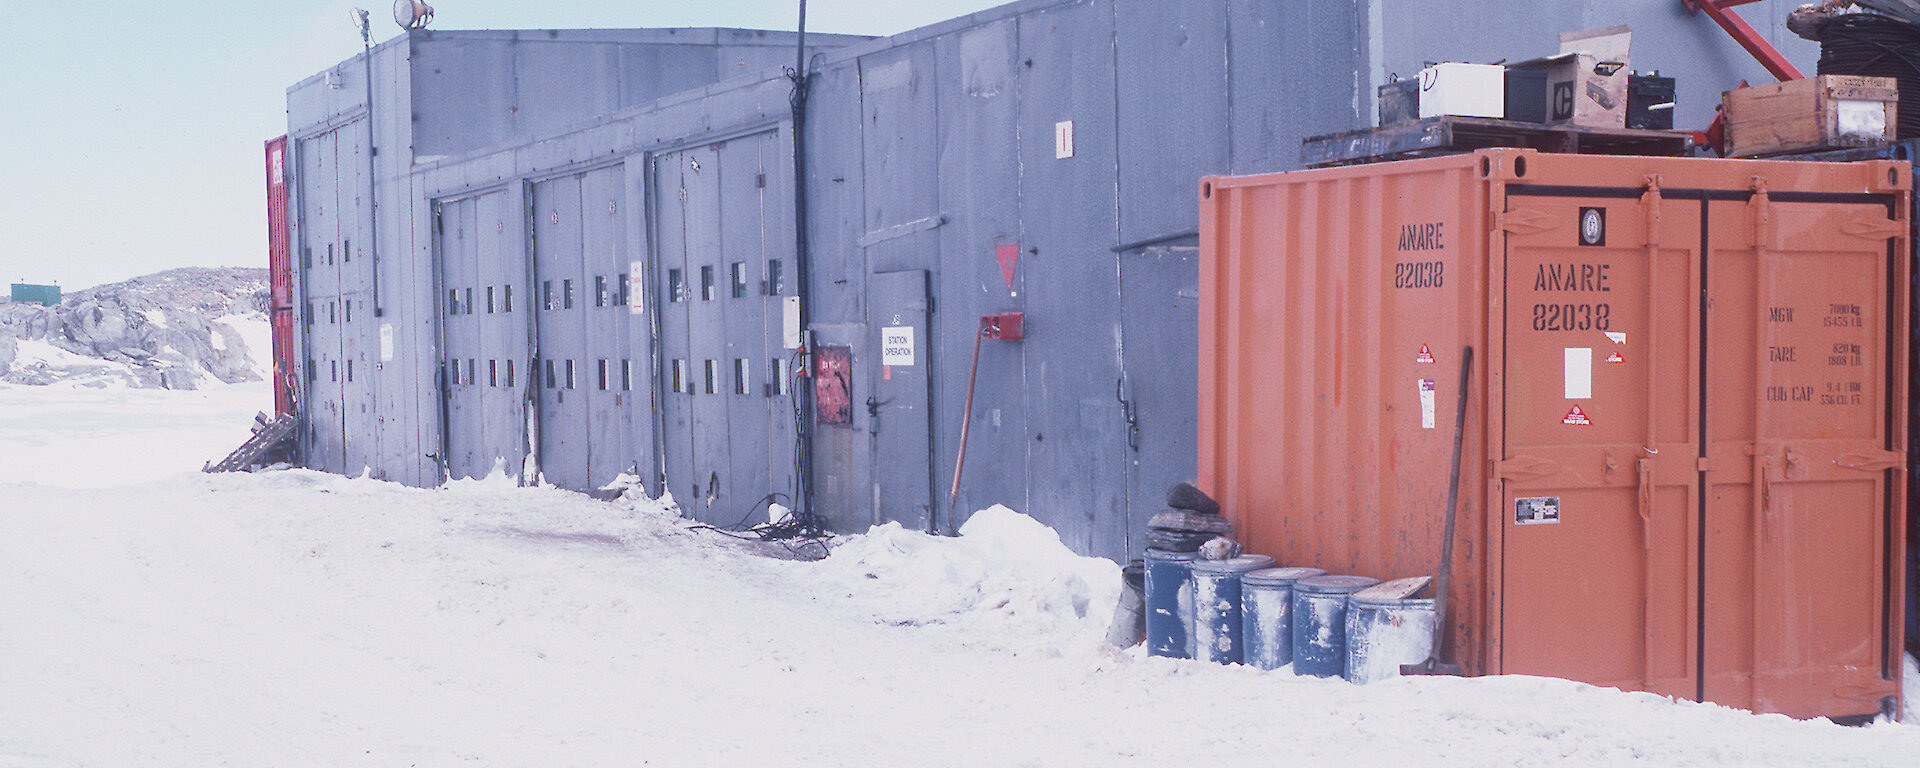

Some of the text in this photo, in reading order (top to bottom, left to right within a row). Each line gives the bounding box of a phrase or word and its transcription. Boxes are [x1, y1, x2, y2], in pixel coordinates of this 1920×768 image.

[1398, 222, 1444, 251] ANARE
[1395, 260, 1444, 288] 82038
[1533, 263, 1611, 292] ANARE
[1532, 303, 1610, 331] 82038
[1769, 306, 1795, 322] MGW
[1850, 303, 1861, 315] kg
[887, 336, 908, 345] STATION
[884, 347, 912, 356] OPERATION
[1768, 346, 1796, 362] TARE
[1850, 343, 1861, 355] kg
[1792, 386, 1814, 402] CAP
